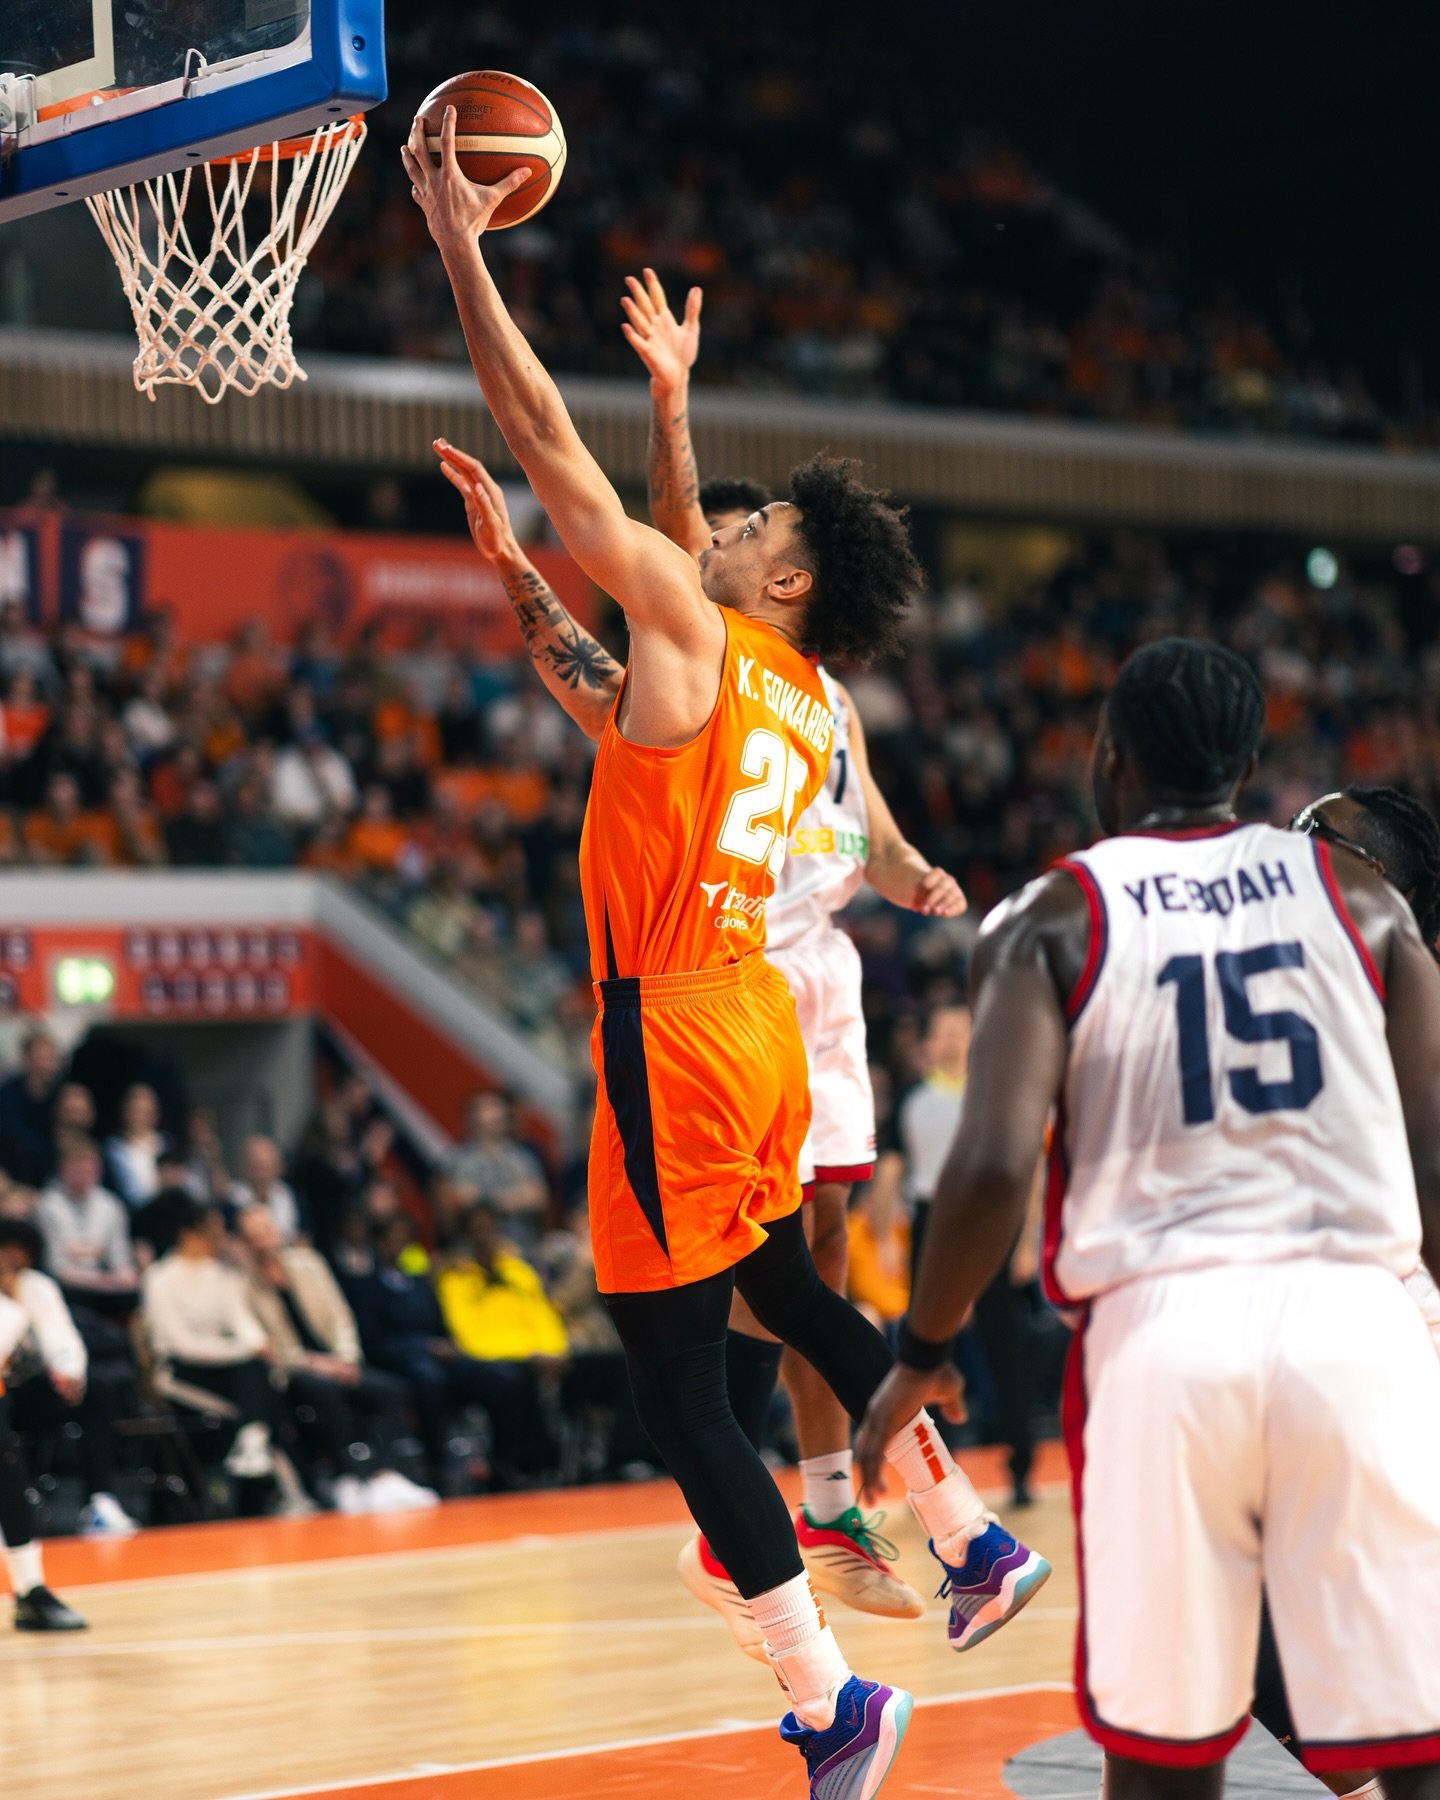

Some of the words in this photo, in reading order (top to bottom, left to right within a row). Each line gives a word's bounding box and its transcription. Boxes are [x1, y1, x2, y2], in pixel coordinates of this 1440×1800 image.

[456, 104, 495, 114] OBASKET
[738, 655, 759, 701] K.
[762, 667, 834, 753] EDWARDS
[1123, 861, 1296, 917] YEBOAH
[1156, 941, 1325, 1127] 15
